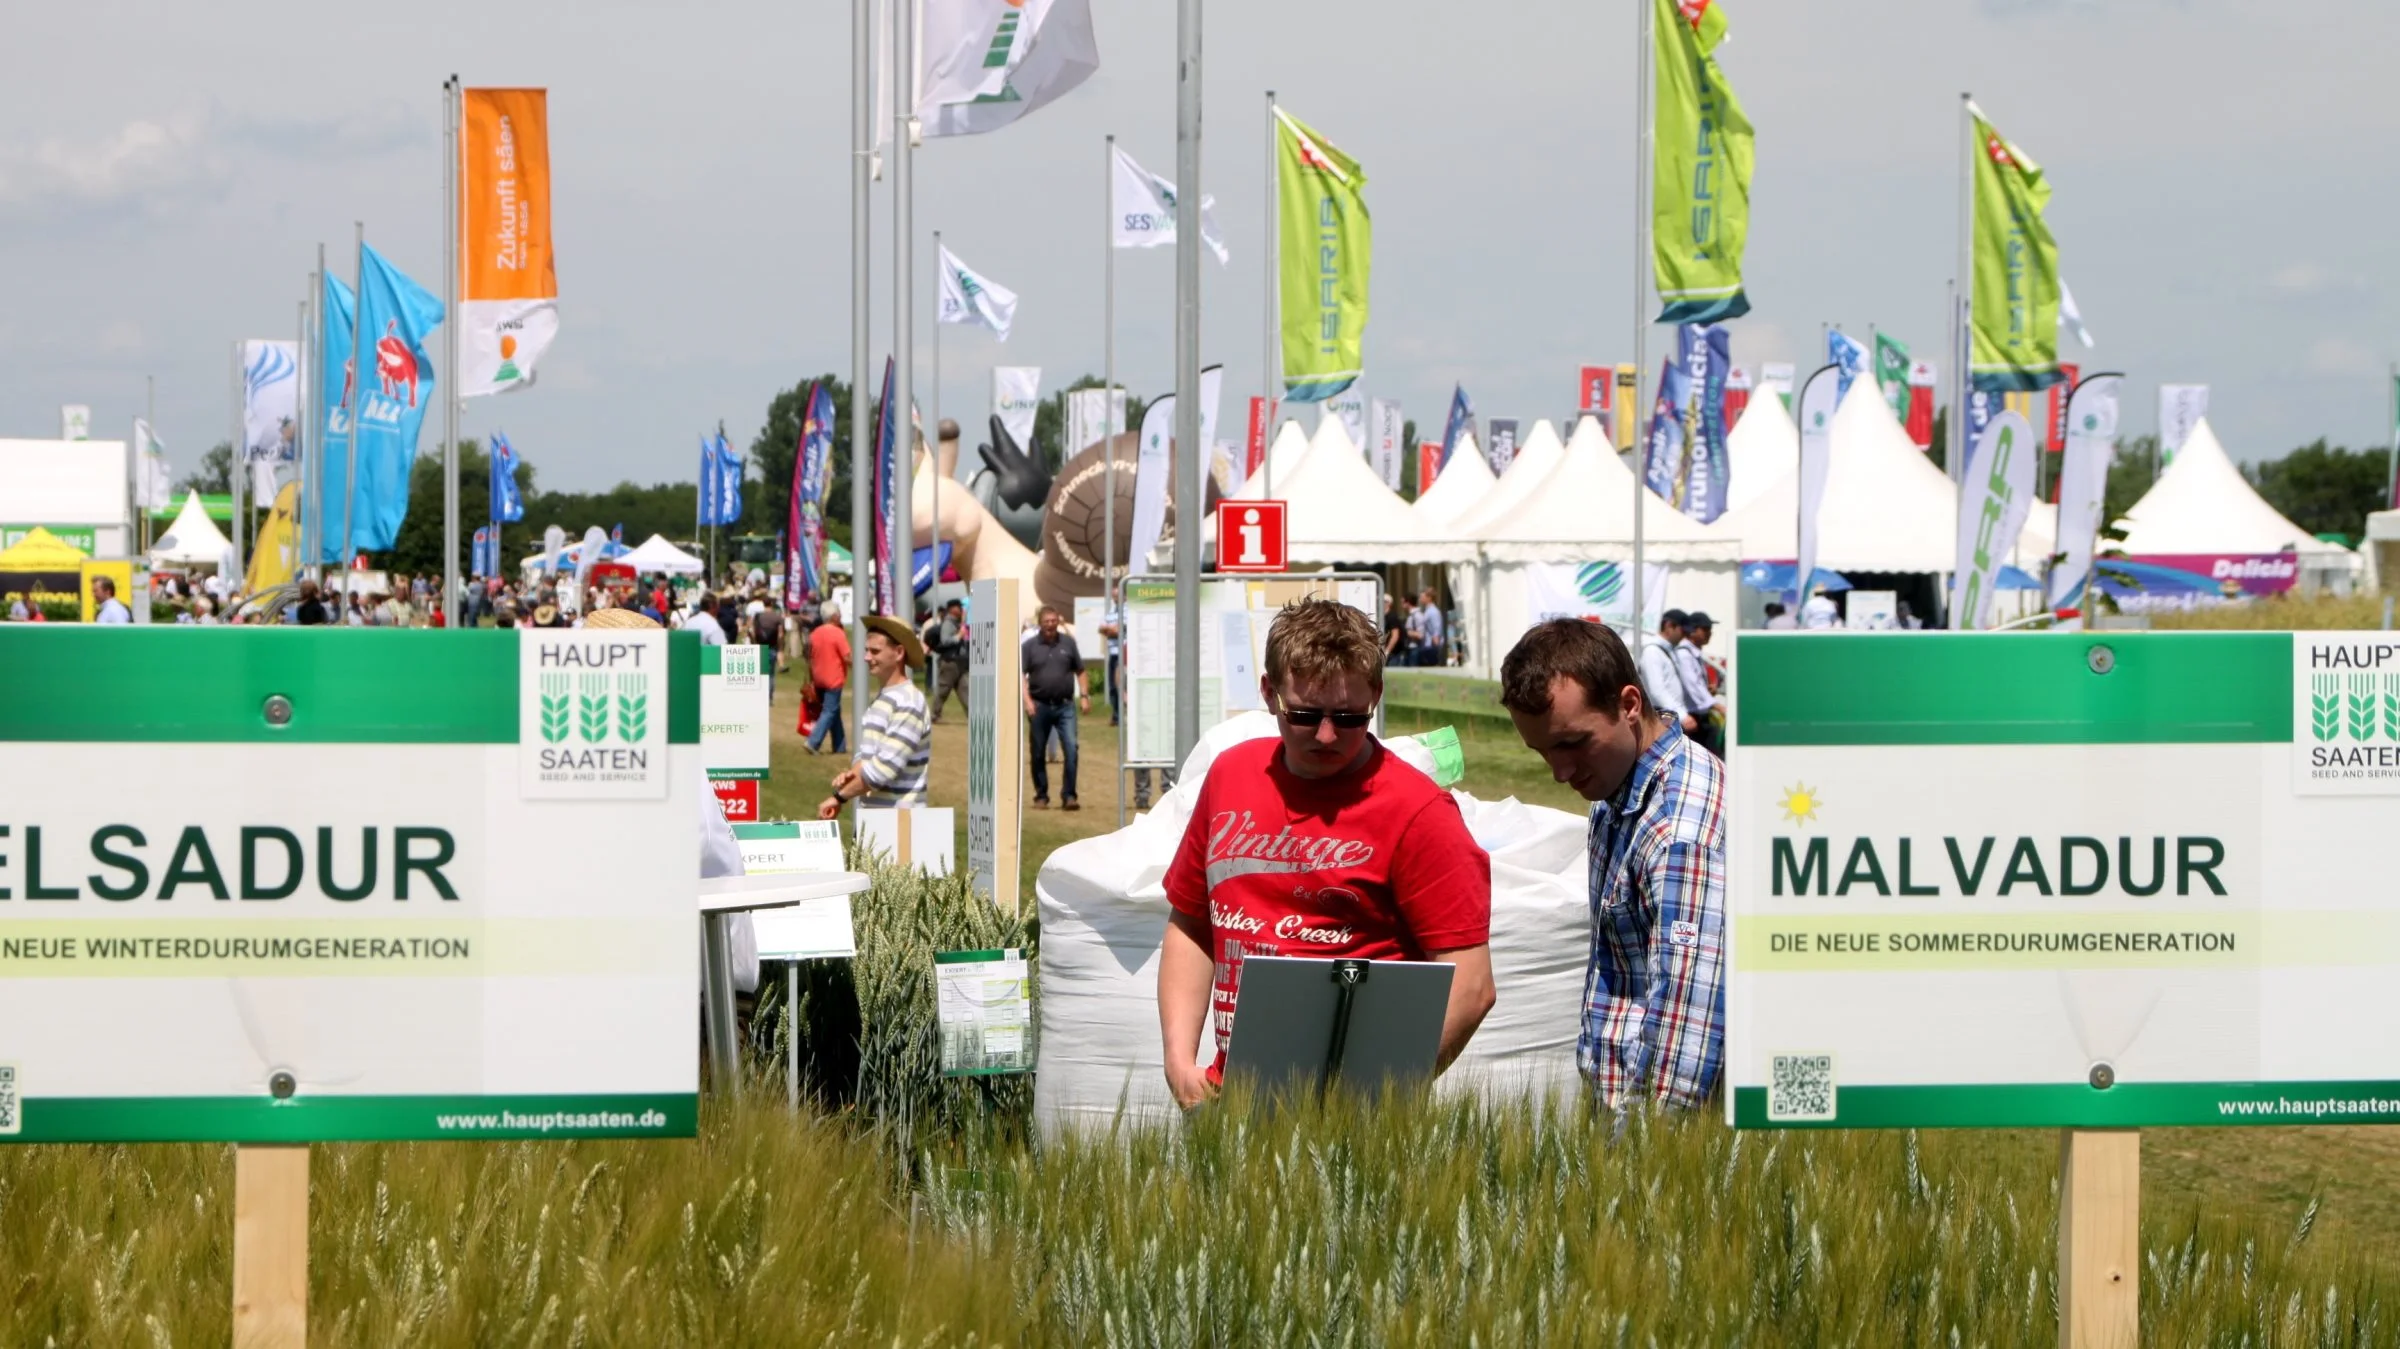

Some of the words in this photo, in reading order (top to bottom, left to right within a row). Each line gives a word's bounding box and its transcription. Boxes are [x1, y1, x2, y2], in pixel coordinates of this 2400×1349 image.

[497, 115, 516, 171] säen
[497, 178, 516, 270] Zukunft
[1319, 196, 1339, 354] ISARIA
[2212, 559, 2295, 578] Delicia
[540, 643, 647, 668] HAUPT
[726, 647, 755, 655] HAUPT
[726, 675, 756, 683] SAATEN
[540, 748, 647, 770] SAATEN
[2311, 769, 2338, 778] SEED
[2342, 769, 2364, 778] AND
[1206, 810, 1374, 867] Vintage
[1771, 836, 2229, 896] MALVADUR
[1274, 914, 1353, 944] Creek
[3, 938, 76, 958] NEUE
[86, 937, 470, 959] WINTERDURUMGENERATION
[1770, 933, 1809, 952] DIE
[1816, 933, 1881, 952] NEUE
[1888, 932, 2236, 953] SOMMERDURUMGENERATION
[436, 1108, 667, 1132] www.hauptsaaten.de
